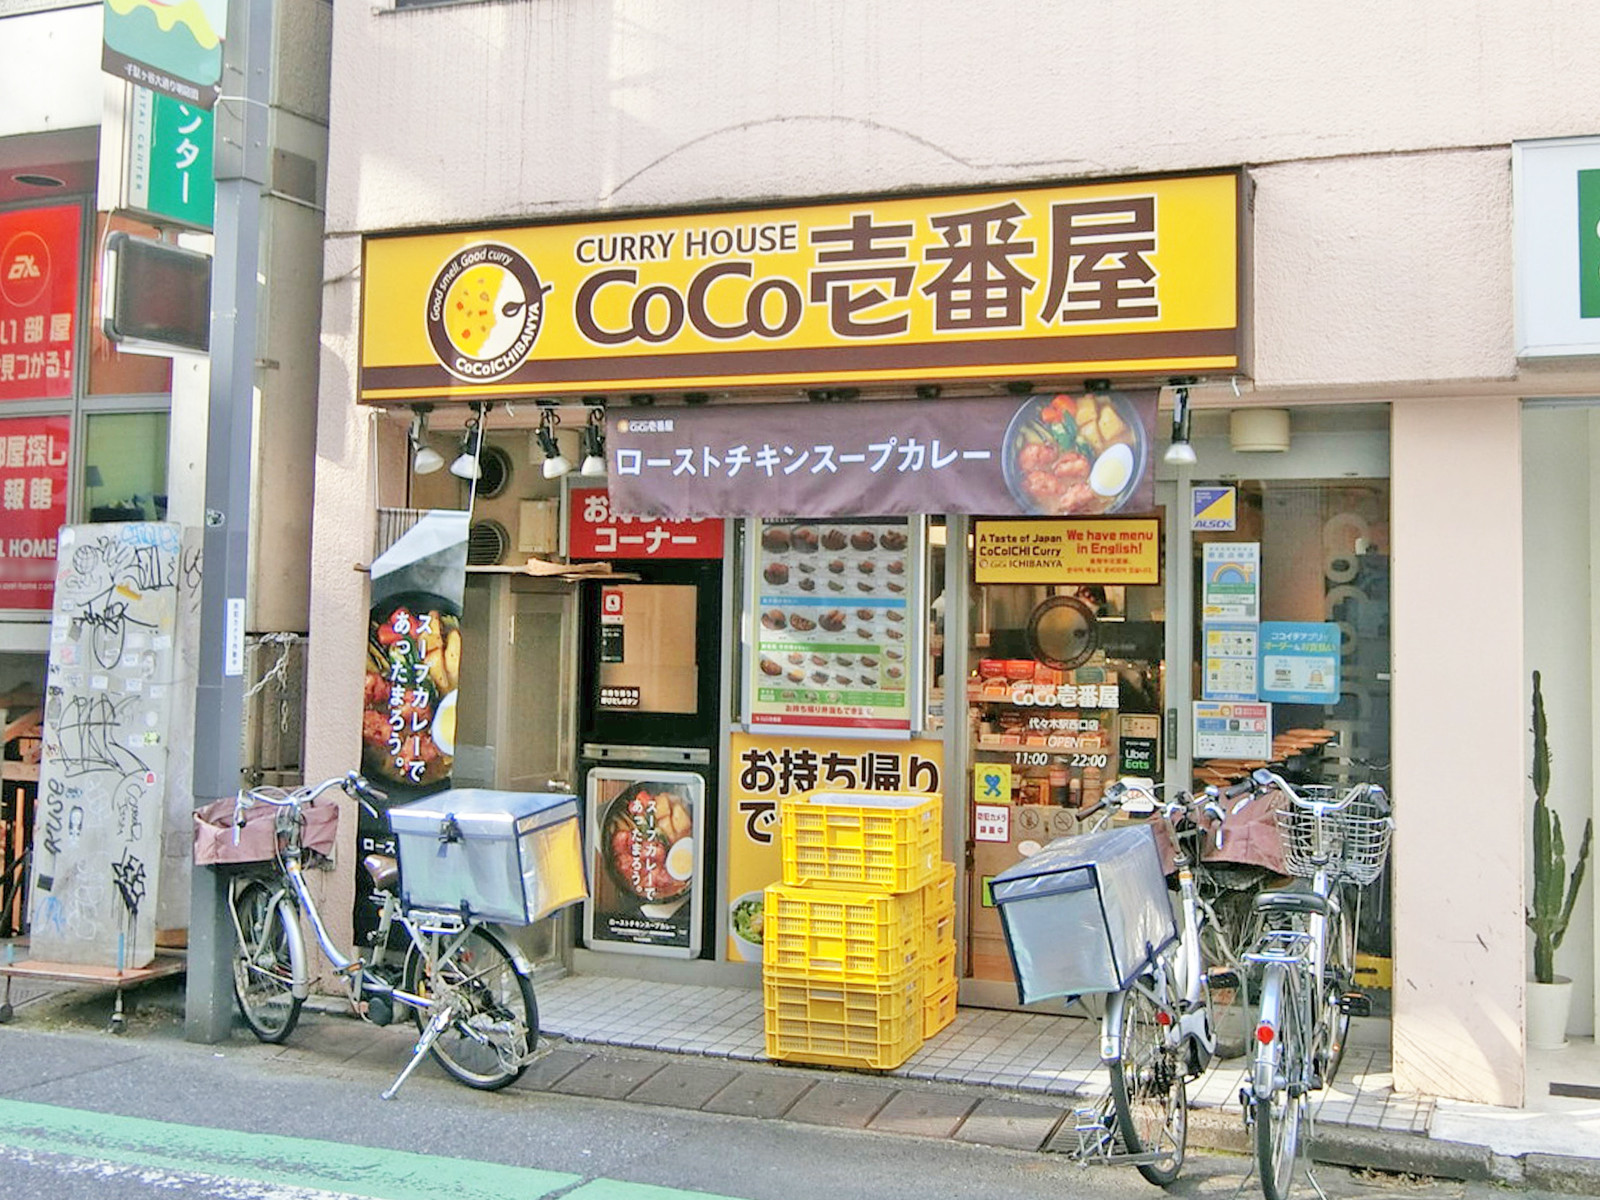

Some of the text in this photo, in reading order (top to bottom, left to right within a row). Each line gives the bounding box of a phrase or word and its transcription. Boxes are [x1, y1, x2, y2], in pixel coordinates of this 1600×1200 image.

[175, 103, 202, 204] ンター
[576, 224, 797, 264] CURRY HOUSE
[575, 196, 1159, 345] CoCo壱番屋
[430, 287, 443, 321] Good
[461, 248, 487, 267] Good
[488, 249, 513, 266] curry
[455, 302, 540, 376] CoCoICHIBANYA
[616, 437, 991, 478] ローストチキンスープカレー
[1194, 519, 1233, 529] ALSOK
[595, 526, 697, 553] コーナー
[980, 534, 1062, 544] A Taste of Japan
[1067, 529, 1154, 541] We have menu
[9, 538, 57, 559] HOME
[979, 546, 1062, 558] CoCoICHI Curry
[1077, 543, 1143, 556] in English!
[1009, 560, 1063, 569] ICHIBANYA
[388, 613, 412, 769] あったまろう。
[409, 614, 433, 783] スープカレーで
[1012, 684, 1119, 708] CoCo壱番屋
[1029, 718, 1099, 731] 代々木駅西口店
[1048, 735, 1080, 748] OPEN
[1015, 752, 1048, 765] 11:00
[1070, 753, 1107, 767] 22:00
[1125, 749, 1150, 760] Uber
[1125, 759, 1150, 770] Eats
[740, 749, 939, 794] お持ち帰り
[978, 812, 1007, 823] 防犯カメラ
[645, 801, 657, 901] スープカレーで
